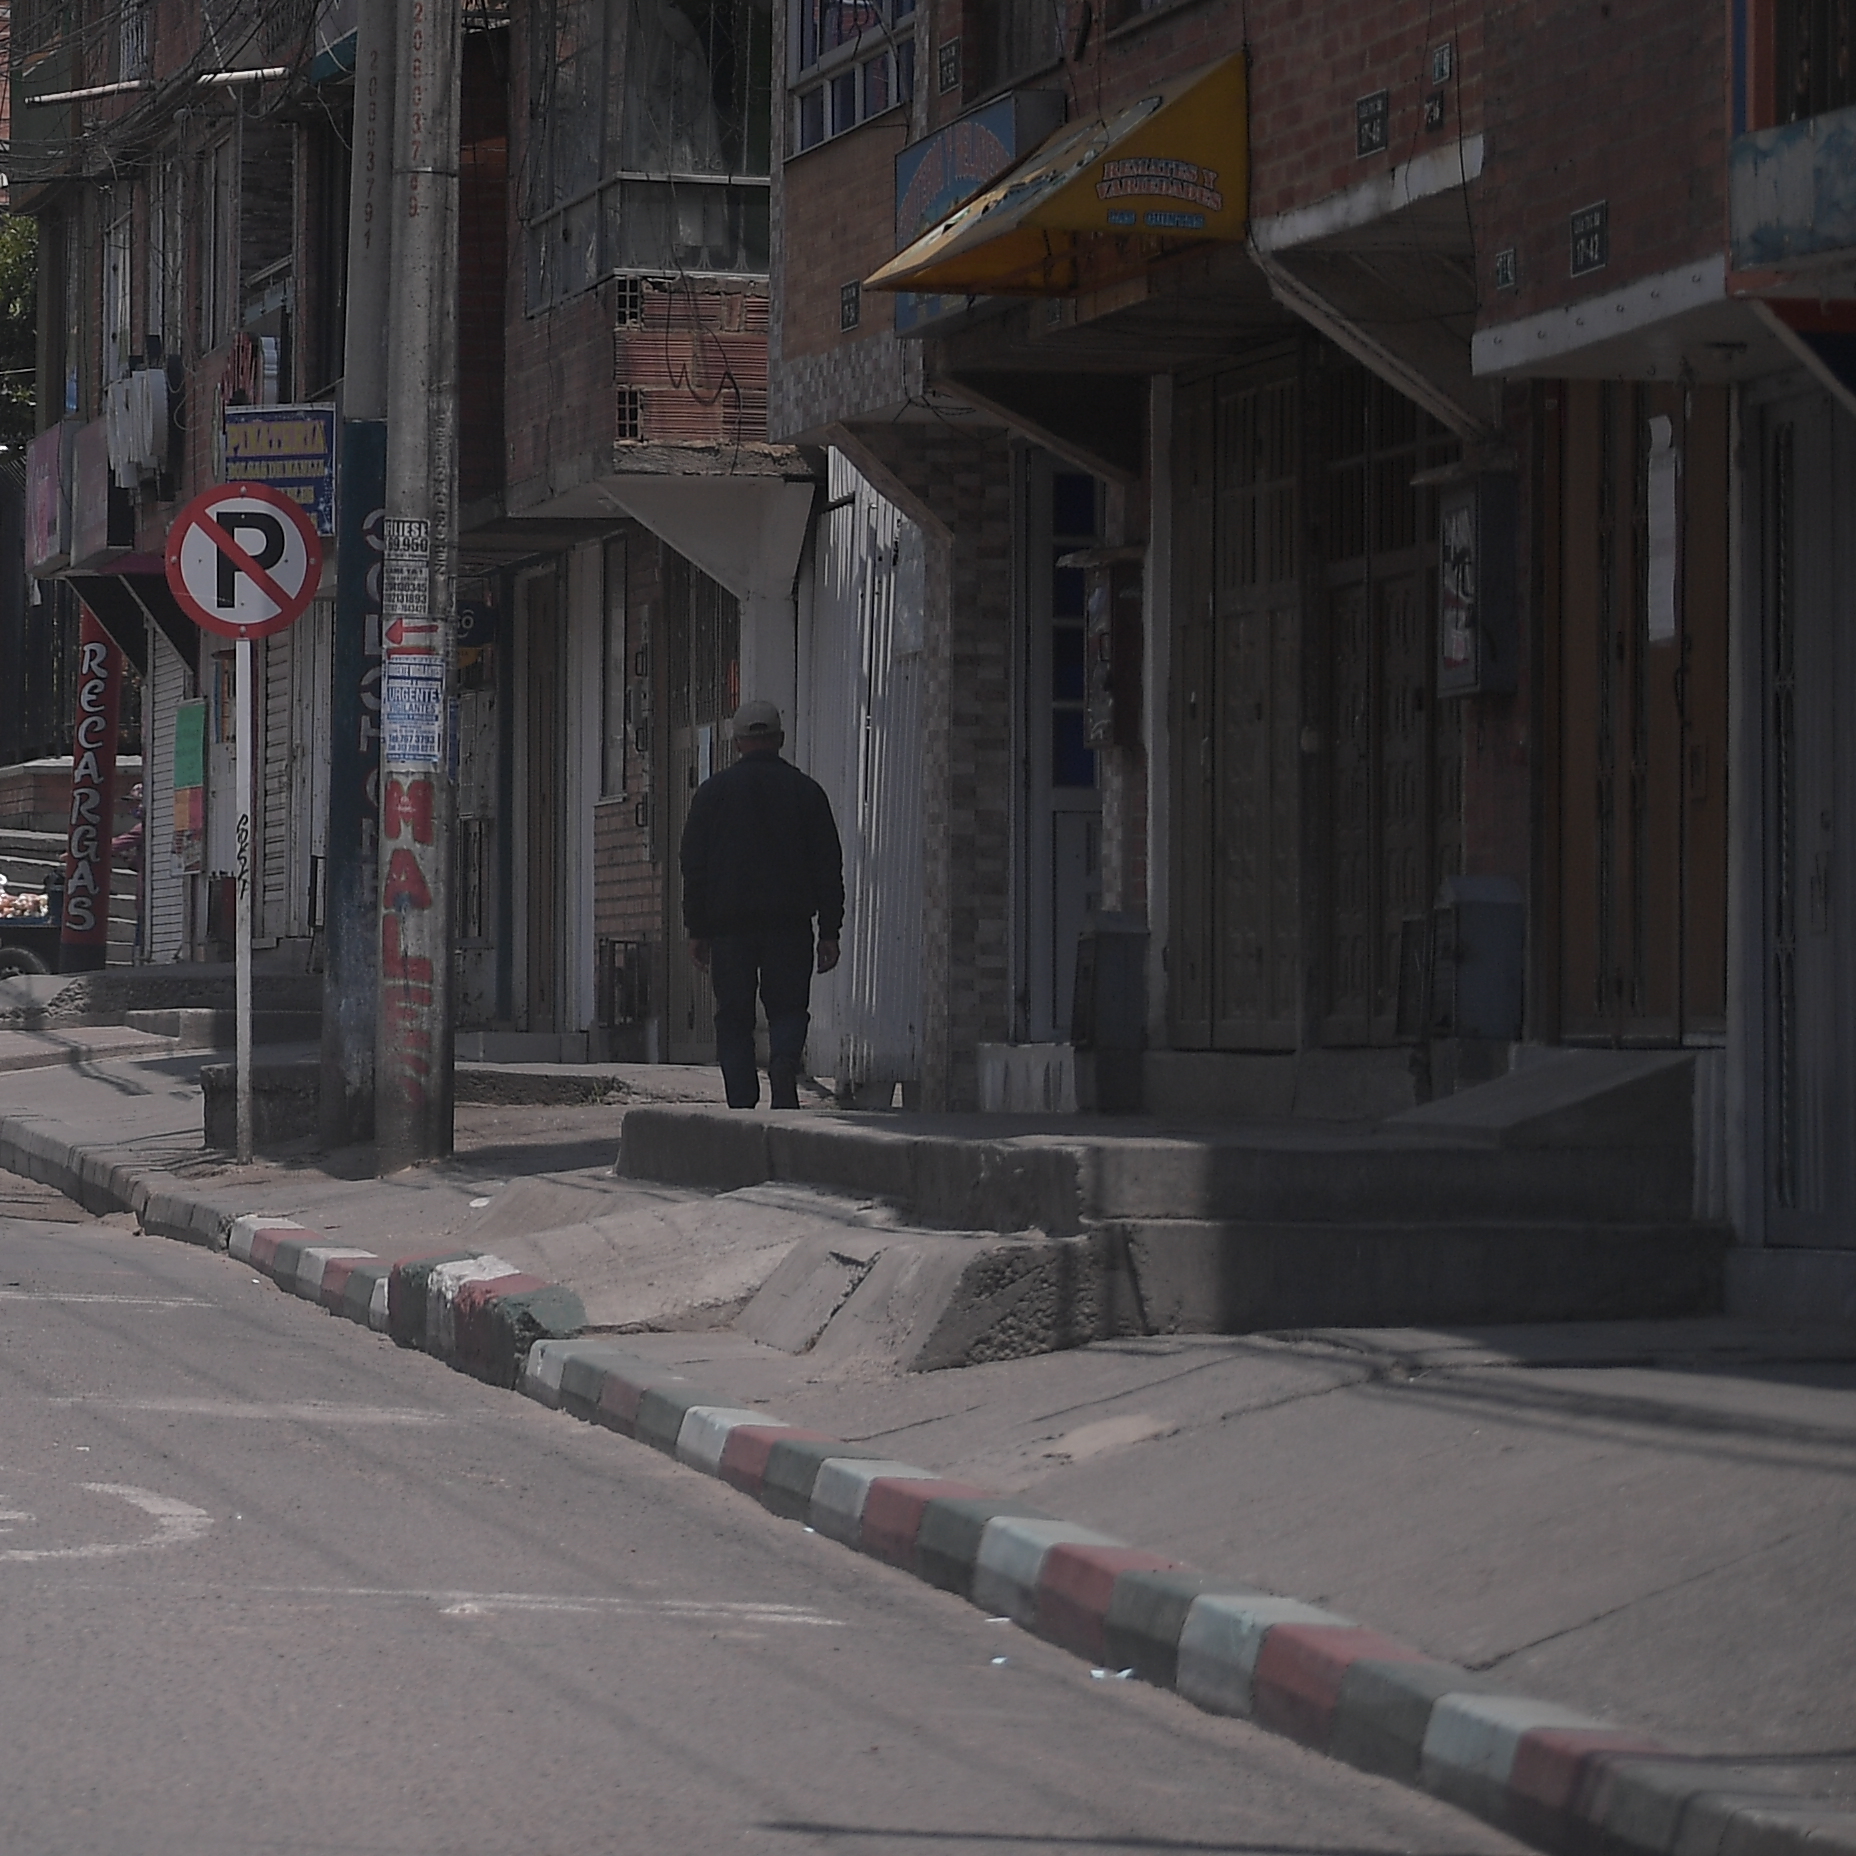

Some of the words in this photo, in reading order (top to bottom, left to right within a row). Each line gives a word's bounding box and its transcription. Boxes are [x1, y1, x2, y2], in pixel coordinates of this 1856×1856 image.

[1096, 176, 1223, 211] VARIEDADES
[389, 686, 437, 702] URGENTE
[65, 642, 108, 931] RECARGAS
